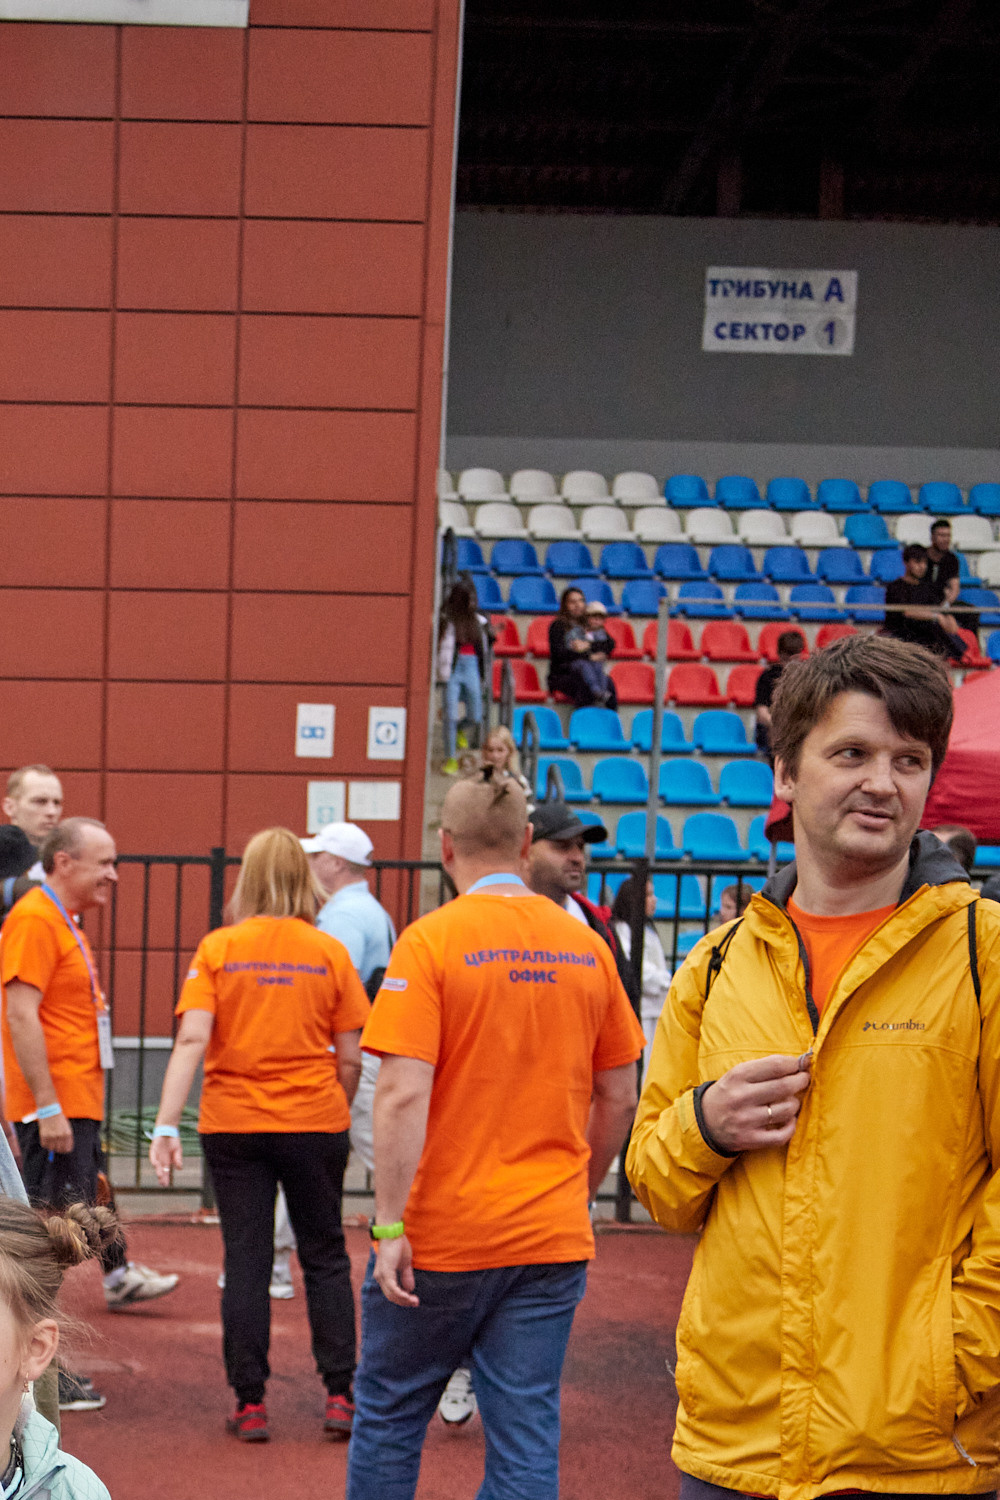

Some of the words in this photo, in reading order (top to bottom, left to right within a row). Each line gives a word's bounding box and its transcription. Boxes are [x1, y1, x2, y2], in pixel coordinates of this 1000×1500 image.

[708, 279, 814, 300] ТРИБУНА
[824, 277, 844, 303] А
[714, 321, 806, 341] СЕКТОР
[823, 320, 835, 345] 1
[463, 949, 597, 968] ЦЕНТРАЛЬНЫЙ
[509, 969, 558, 983] ОФИС
